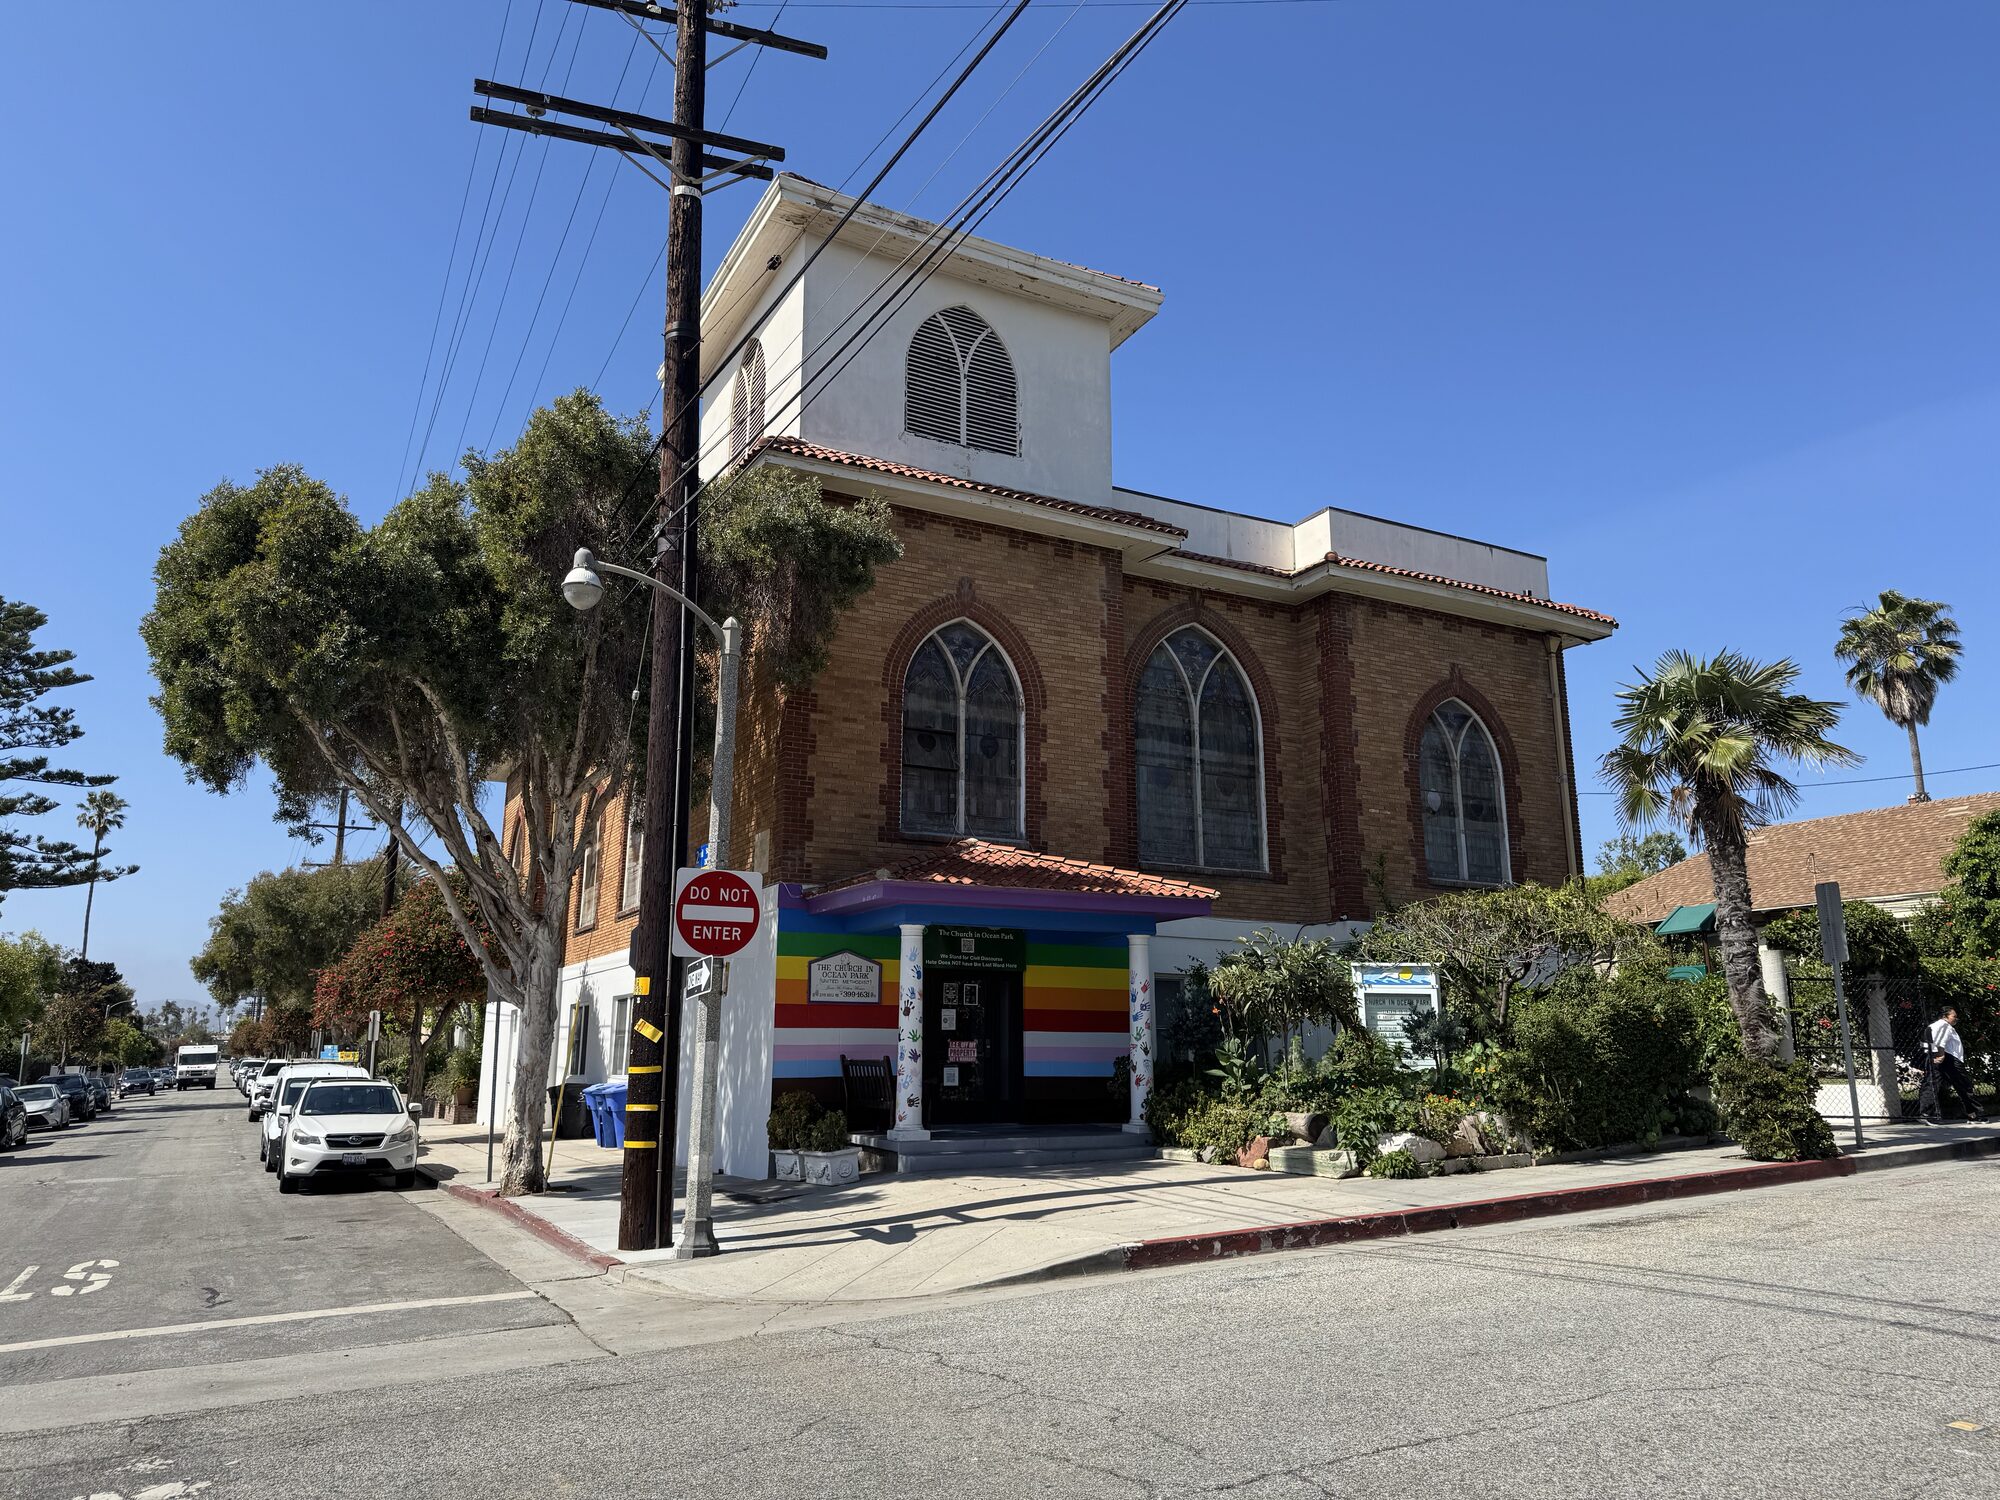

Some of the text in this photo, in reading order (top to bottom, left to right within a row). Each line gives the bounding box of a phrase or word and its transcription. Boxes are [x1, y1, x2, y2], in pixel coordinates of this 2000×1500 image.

[543, 94, 551, 104] N
[689, 886, 750, 903] DO NOT
[692, 925, 741, 941] ENTER
[950, 930, 973, 938] Church
[816, 963, 874, 973] THE CHURCH IN
[822, 971, 848, 979] OCEAN
[1365, 998, 1386, 1006] CHURCH
[1388, 998, 1395, 1006] IN
